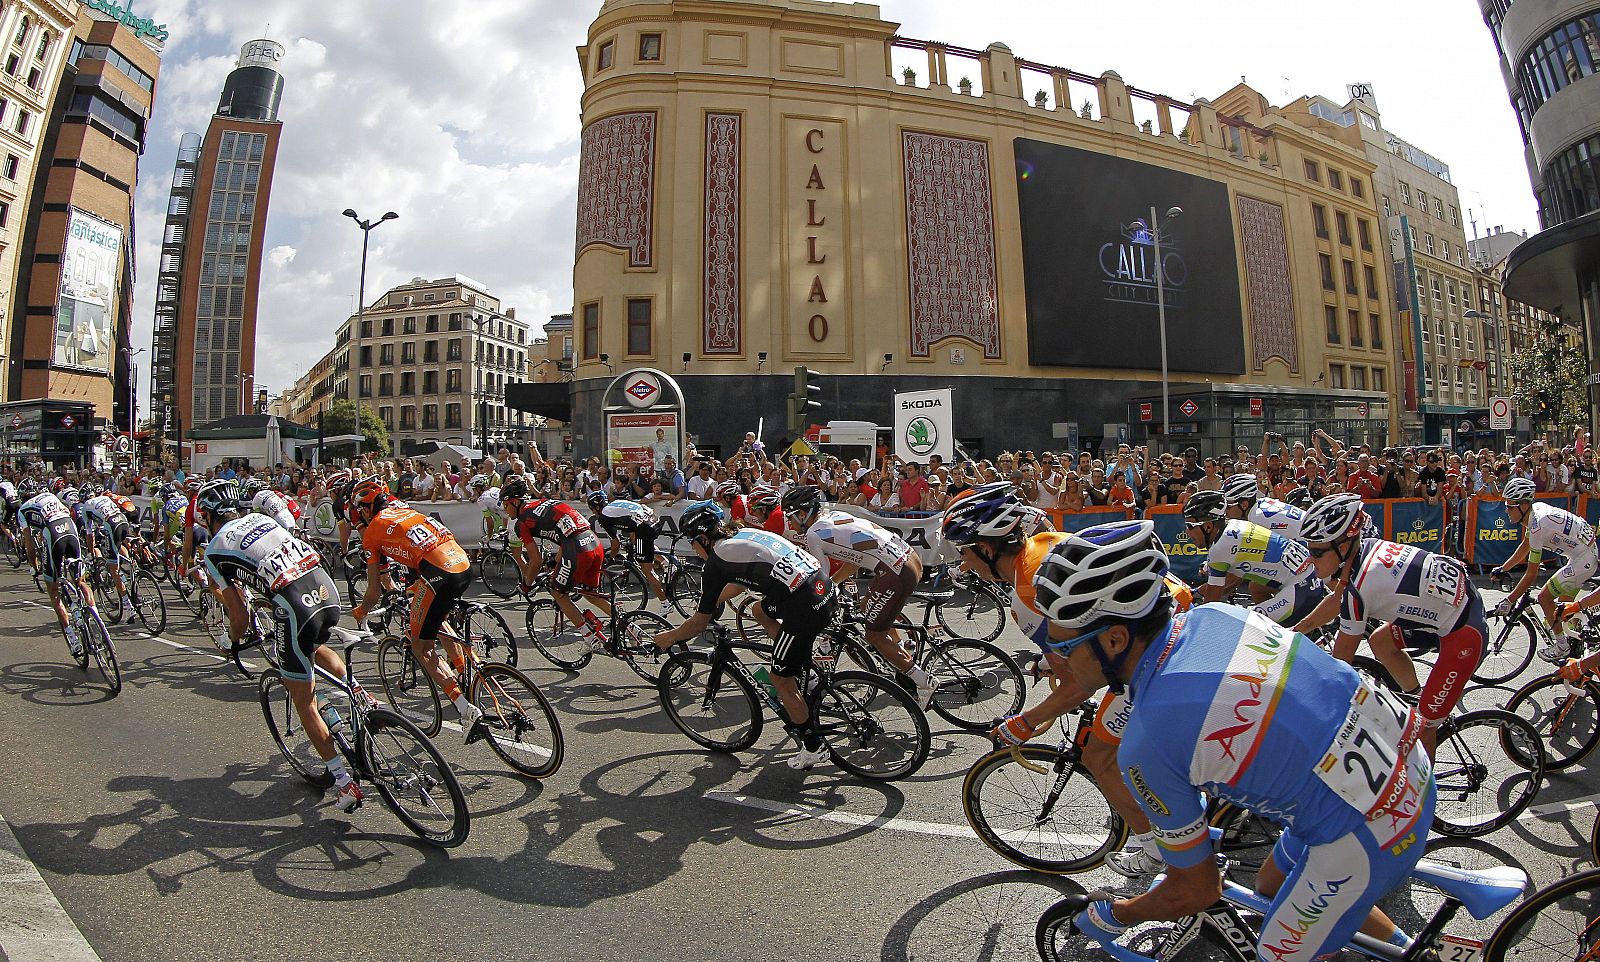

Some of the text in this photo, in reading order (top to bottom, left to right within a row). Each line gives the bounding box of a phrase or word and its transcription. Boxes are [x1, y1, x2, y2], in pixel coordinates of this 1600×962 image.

[71, 219, 118, 250] fantástica
[806, 128, 829, 343] CALLAO
[632, 386, 651, 394] Metro
[901, 399, 942, 410] ŠKODA
[163, 404, 172, 433] fnac
[615, 464, 652, 476] crer
[242, 529, 262, 548] QUICK
[409, 527, 429, 542] 79
[540, 529, 560, 541] BMC
[579, 533, 596, 547] BMC
[1396, 528, 1439, 544] RACE
[1479, 528, 1519, 541] RACE
[263, 553, 288, 580] 147
[1284, 547, 1304, 569] 151
[555, 556, 572, 586] BMC
[1252, 567, 1279, 577] ORICA
[1435, 562, 1459, 597] 136
[301, 589, 321, 608] Q8
[872, 590, 883, 601] LA
[866, 589, 896, 624] MONDIALE
[1266, 598, 1290, 613] ORICA
[1405, 605, 1439, 622] BELISOL
[934, 629, 944, 637] 15
[733, 661, 770, 701] DOGMA
[1427, 671, 1458, 714] Adecco
[1343, 727, 1393, 796] 27
[1053, 761, 1074, 796] Rabobank
[1442, 820, 1497, 834] BORA
[1262, 875, 1353, 962] Andalucía
[1449, 946, 1477, 962] 27
